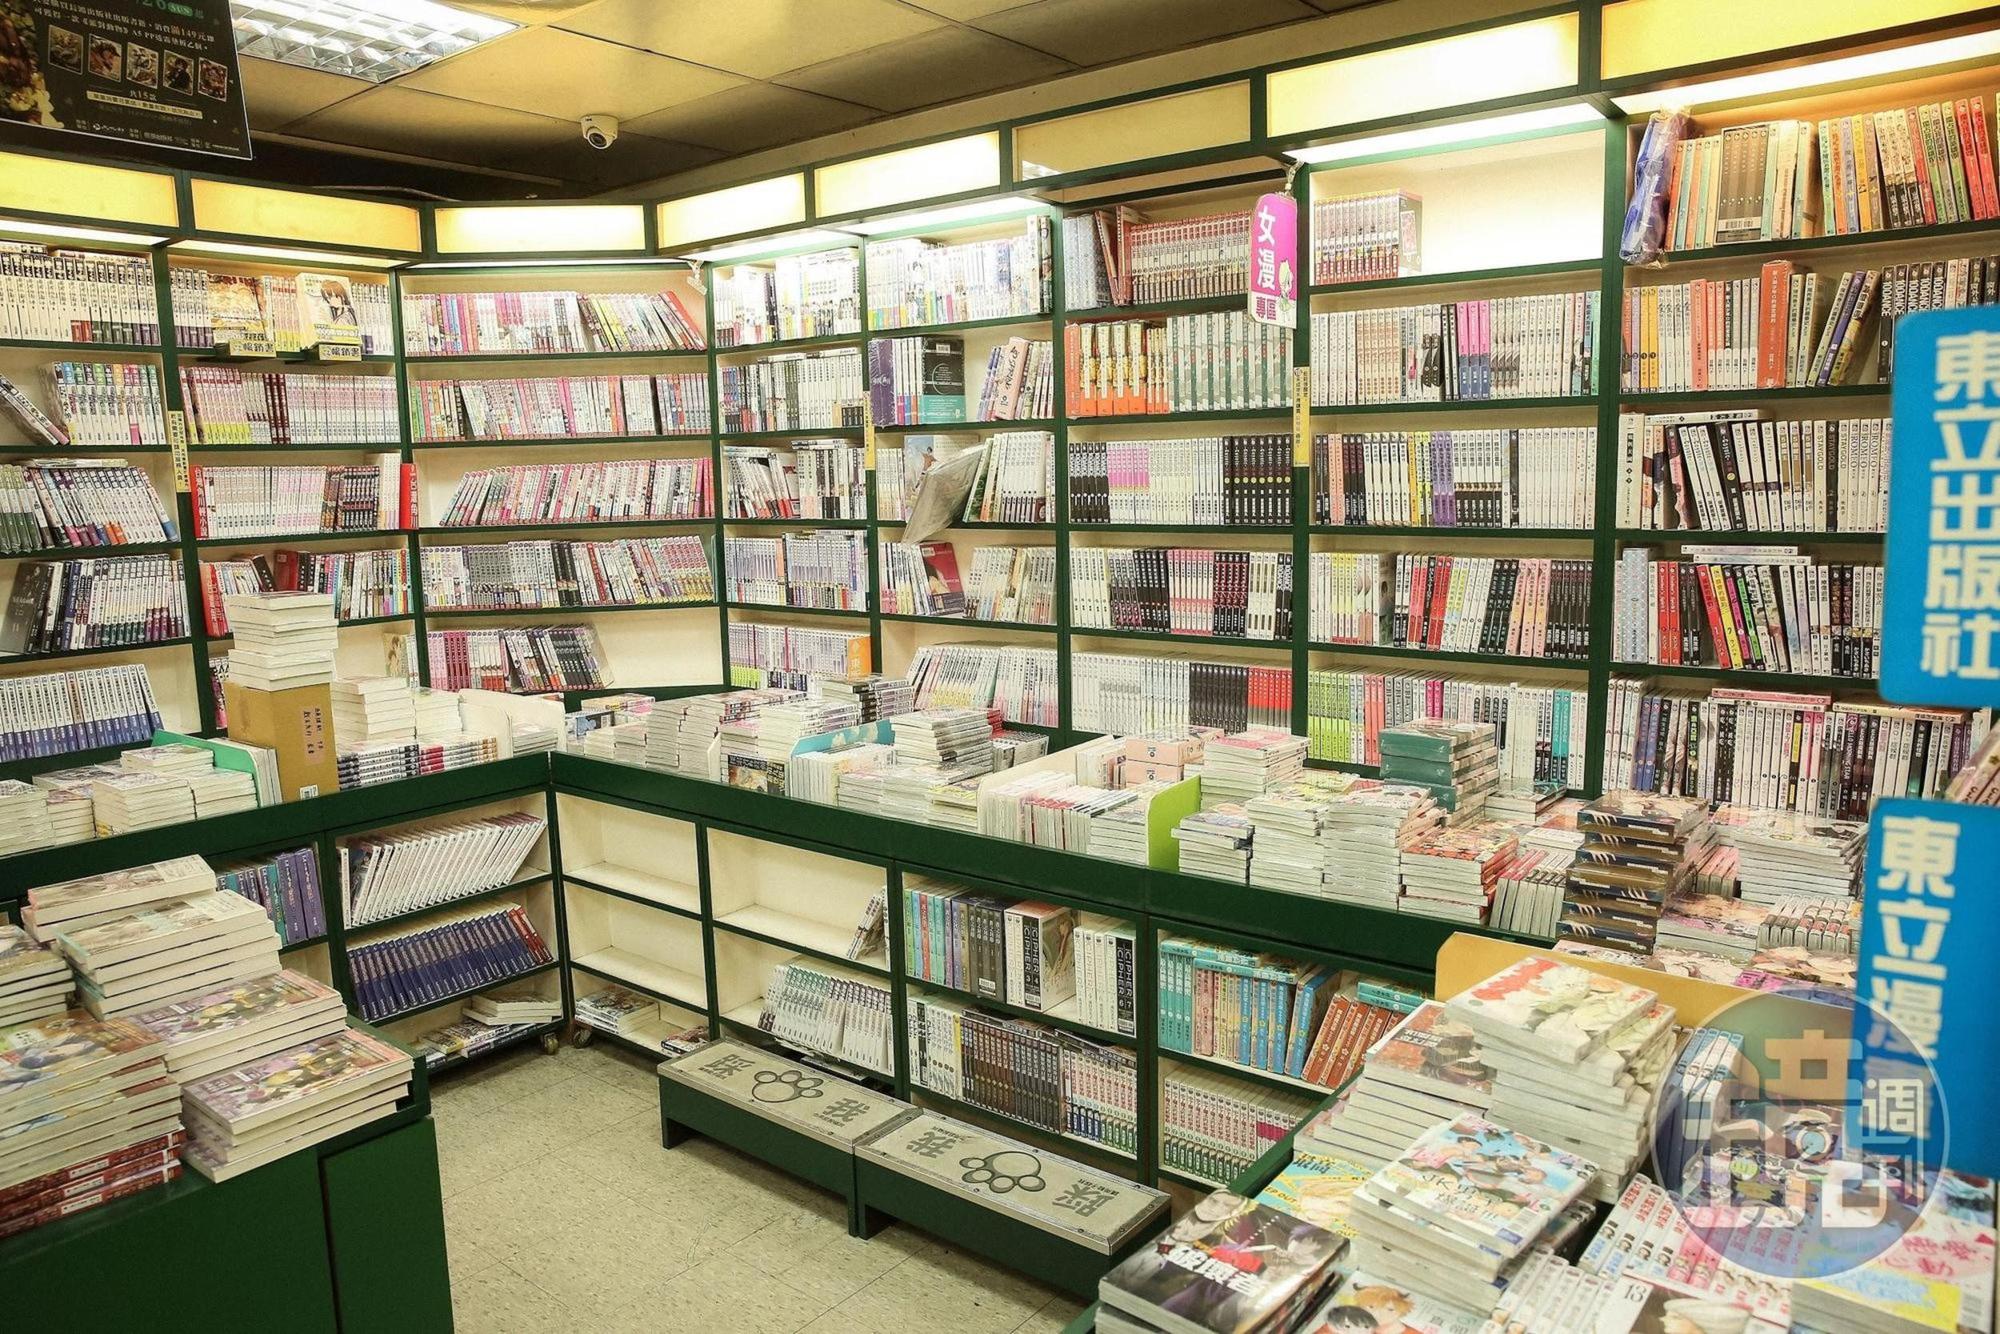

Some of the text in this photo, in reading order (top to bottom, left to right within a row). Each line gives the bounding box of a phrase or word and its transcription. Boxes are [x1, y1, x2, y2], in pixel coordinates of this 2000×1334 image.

[1921, 331, 2000, 680] 東立出版社
[1023, 926, 1031, 972] CIPHER
[1031, 927, 1039, 973] CIPHER
[1117, 948, 1125, 996] CIPHER
[1125, 949, 1133, 998] CIPHER
[823, 1097, 870, 1123] 我
[1623, 1283, 1645, 1303] 13
